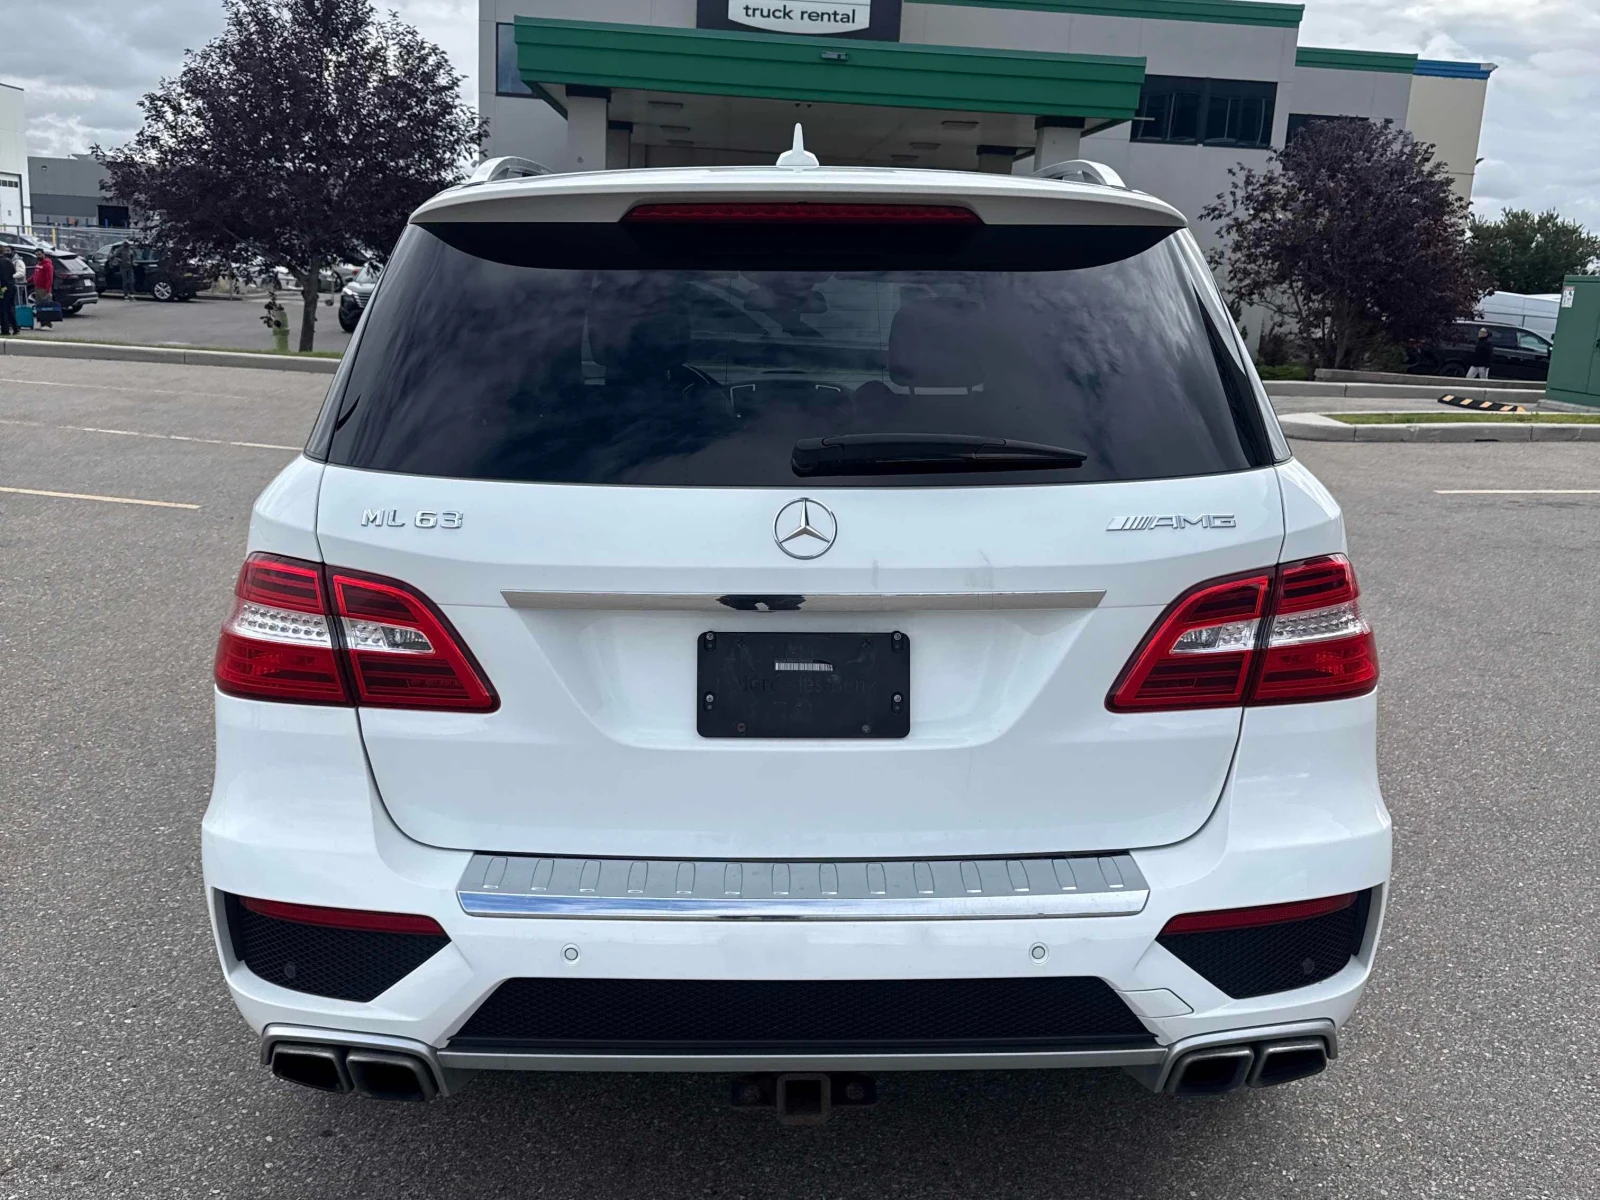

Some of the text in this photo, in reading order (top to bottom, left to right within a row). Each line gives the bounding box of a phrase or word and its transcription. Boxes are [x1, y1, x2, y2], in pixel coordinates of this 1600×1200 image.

[743, 5, 856, 24] truck rental
[361, 509, 464, 529] ML 63
[1147, 513, 1237, 530] AMG
